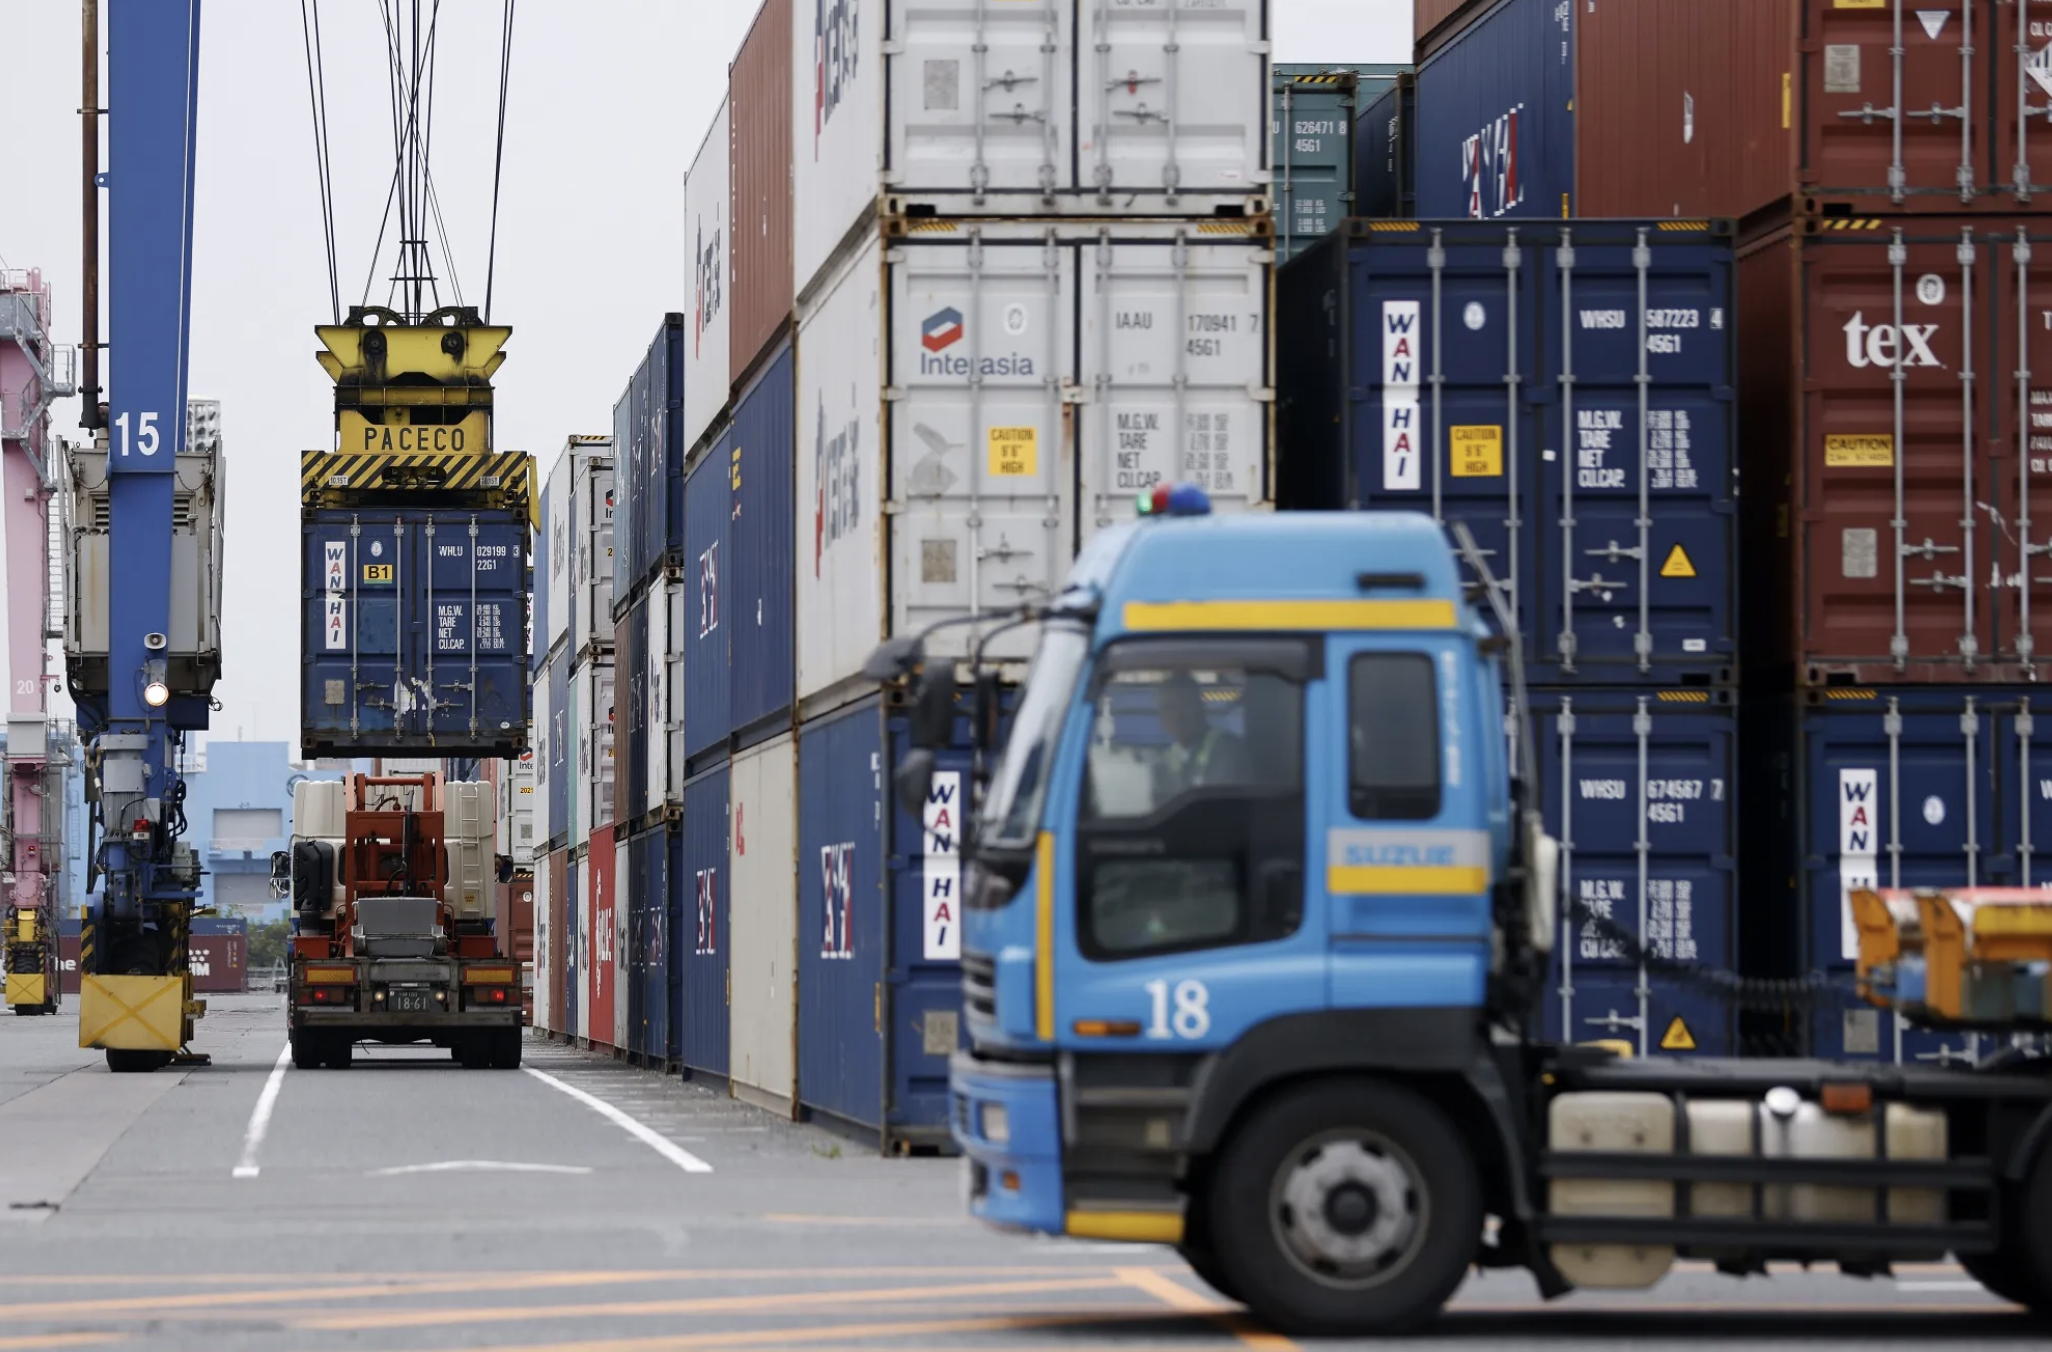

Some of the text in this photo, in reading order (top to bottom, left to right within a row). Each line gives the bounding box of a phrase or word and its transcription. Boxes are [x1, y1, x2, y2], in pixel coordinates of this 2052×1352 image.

[1295, 121, 1334, 134] 626471
[1295, 139, 1321, 152] 45G1
[1842, 310, 1941, 368] tex
[1388, 314, 1414, 476] WAN HAI
[115, 411, 160, 457] 15
[364, 427, 465, 451] PACECO
[1828, 438, 1889, 450] CAUTION
[1001, 461, 1024, 473] HIGH
[438, 546, 463, 556] WHLU
[476, 546, 506, 556] 029199
[477, 559, 497, 570] 22G1
[368, 566, 390, 579] B1
[327, 548, 343, 642] WAN HAI
[439, 617, 456, 627] TARE
[439, 628, 452, 638] NET
[17, 680, 34, 694] 20
[1844, 782, 1871, 850] WAN
[929, 785, 955, 946] WAN HAI
[189, 963, 210, 976] IM
[398, 997, 426, 1010] 18-61
[1145, 979, 1210, 1039] 18
